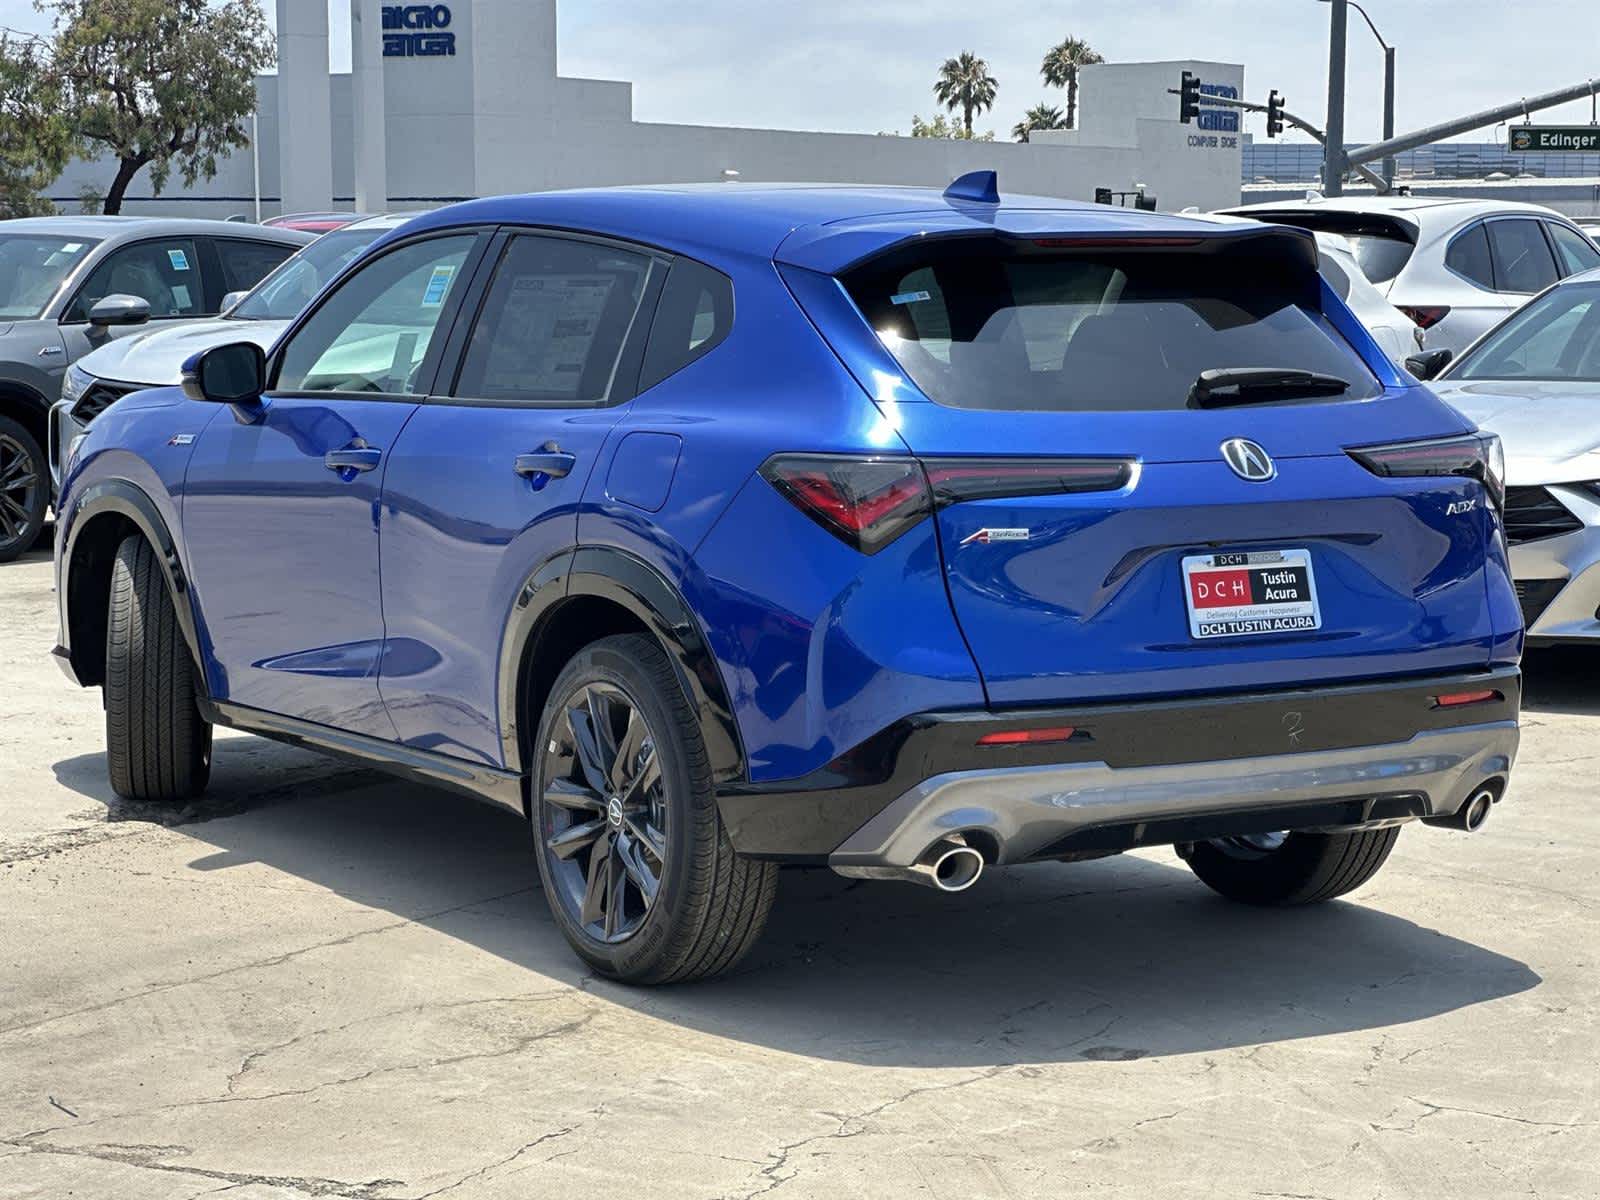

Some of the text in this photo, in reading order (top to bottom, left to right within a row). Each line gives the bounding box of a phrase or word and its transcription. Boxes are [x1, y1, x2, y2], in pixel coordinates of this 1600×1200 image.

[1187, 135, 1238, 149] COMPUTER STORE
[1540, 133, 1597, 149] Edinger
[1446, 499, 1477, 516] ADX
[1220, 554, 1243, 565] DCH
[1260, 570, 1297, 585] Tustin
[1265, 587, 1298, 601] Acura
[1238, 607, 1269, 618] Customer
[1200, 616, 1315, 635] DCH TUSTIN ACURA
